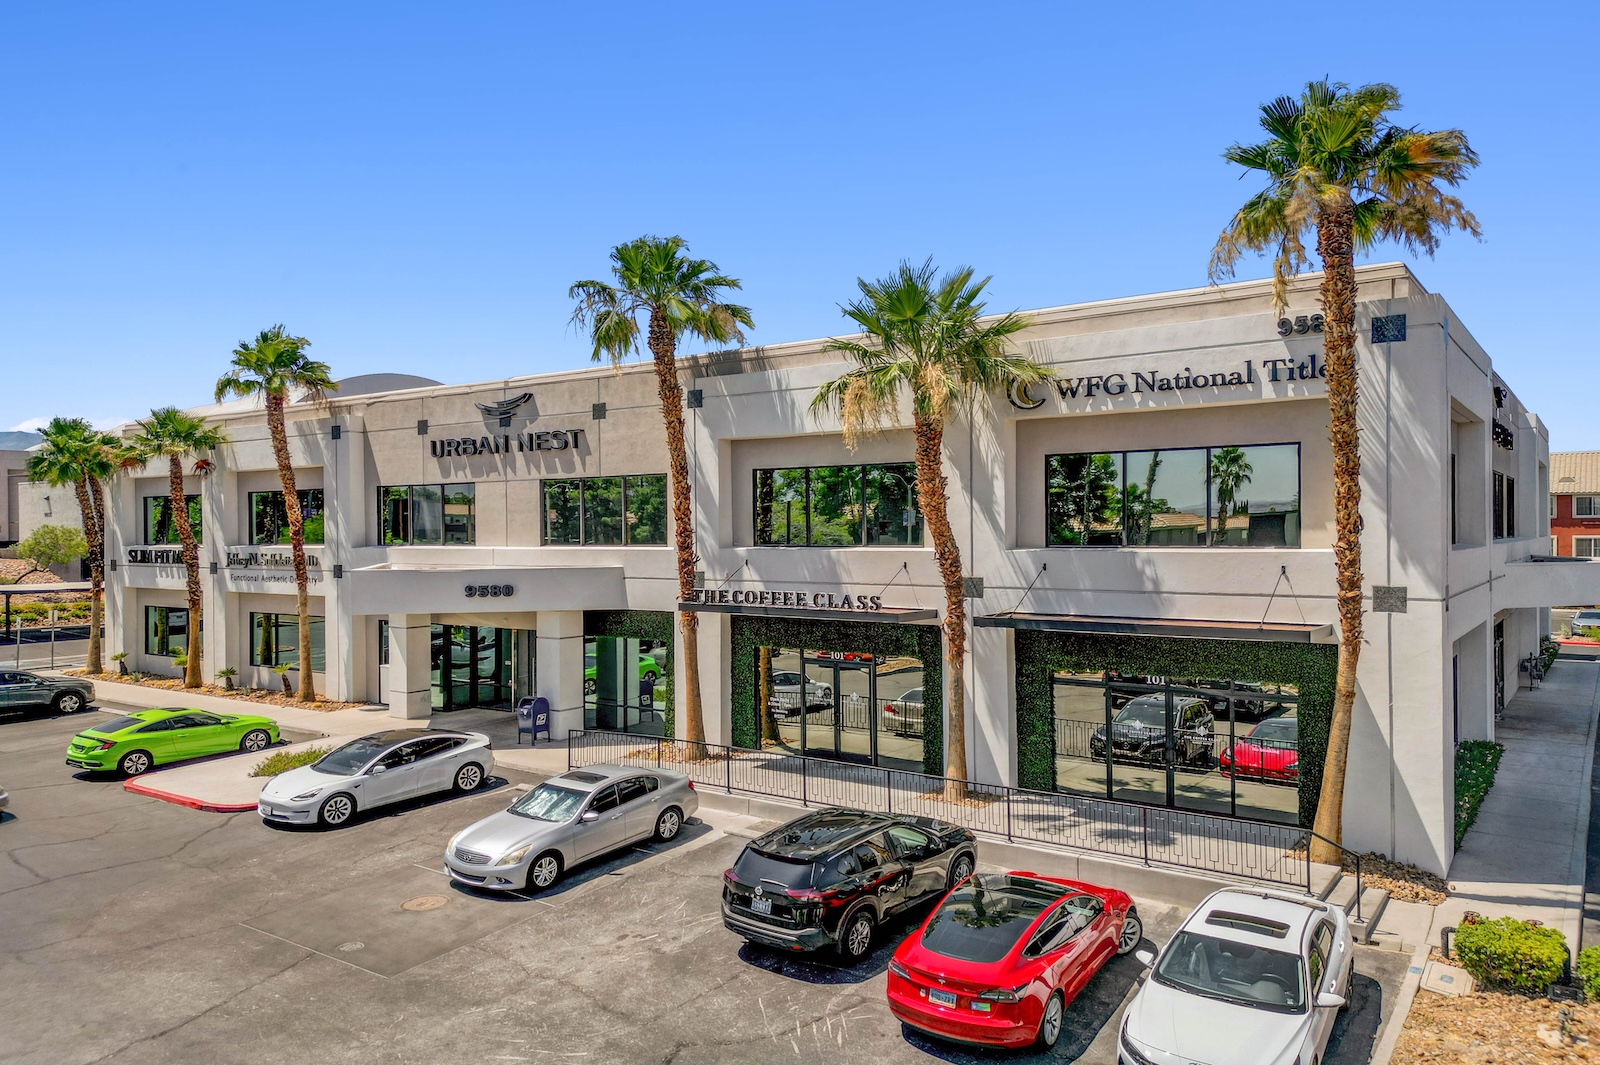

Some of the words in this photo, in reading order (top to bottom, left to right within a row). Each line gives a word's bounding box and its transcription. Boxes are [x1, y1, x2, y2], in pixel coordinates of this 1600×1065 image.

[1277, 313, 1325, 336] 958
[1055, 373, 1125, 399] WFG
[1131, 360, 1255, 393] National
[430, 434, 510, 458] URBAN
[517, 428, 585, 452] NEST
[230, 573, 260, 583] Functional
[261, 574, 288, 584] Aesthetic
[464, 584, 514, 598] 9580
[693, 589, 729, 605] THE
[731, 589, 808, 608] COFFEE
[812, 592, 883, 612] CLASS
[831, 651, 845, 660] 101
[1146, 675, 1166, 686] 101
